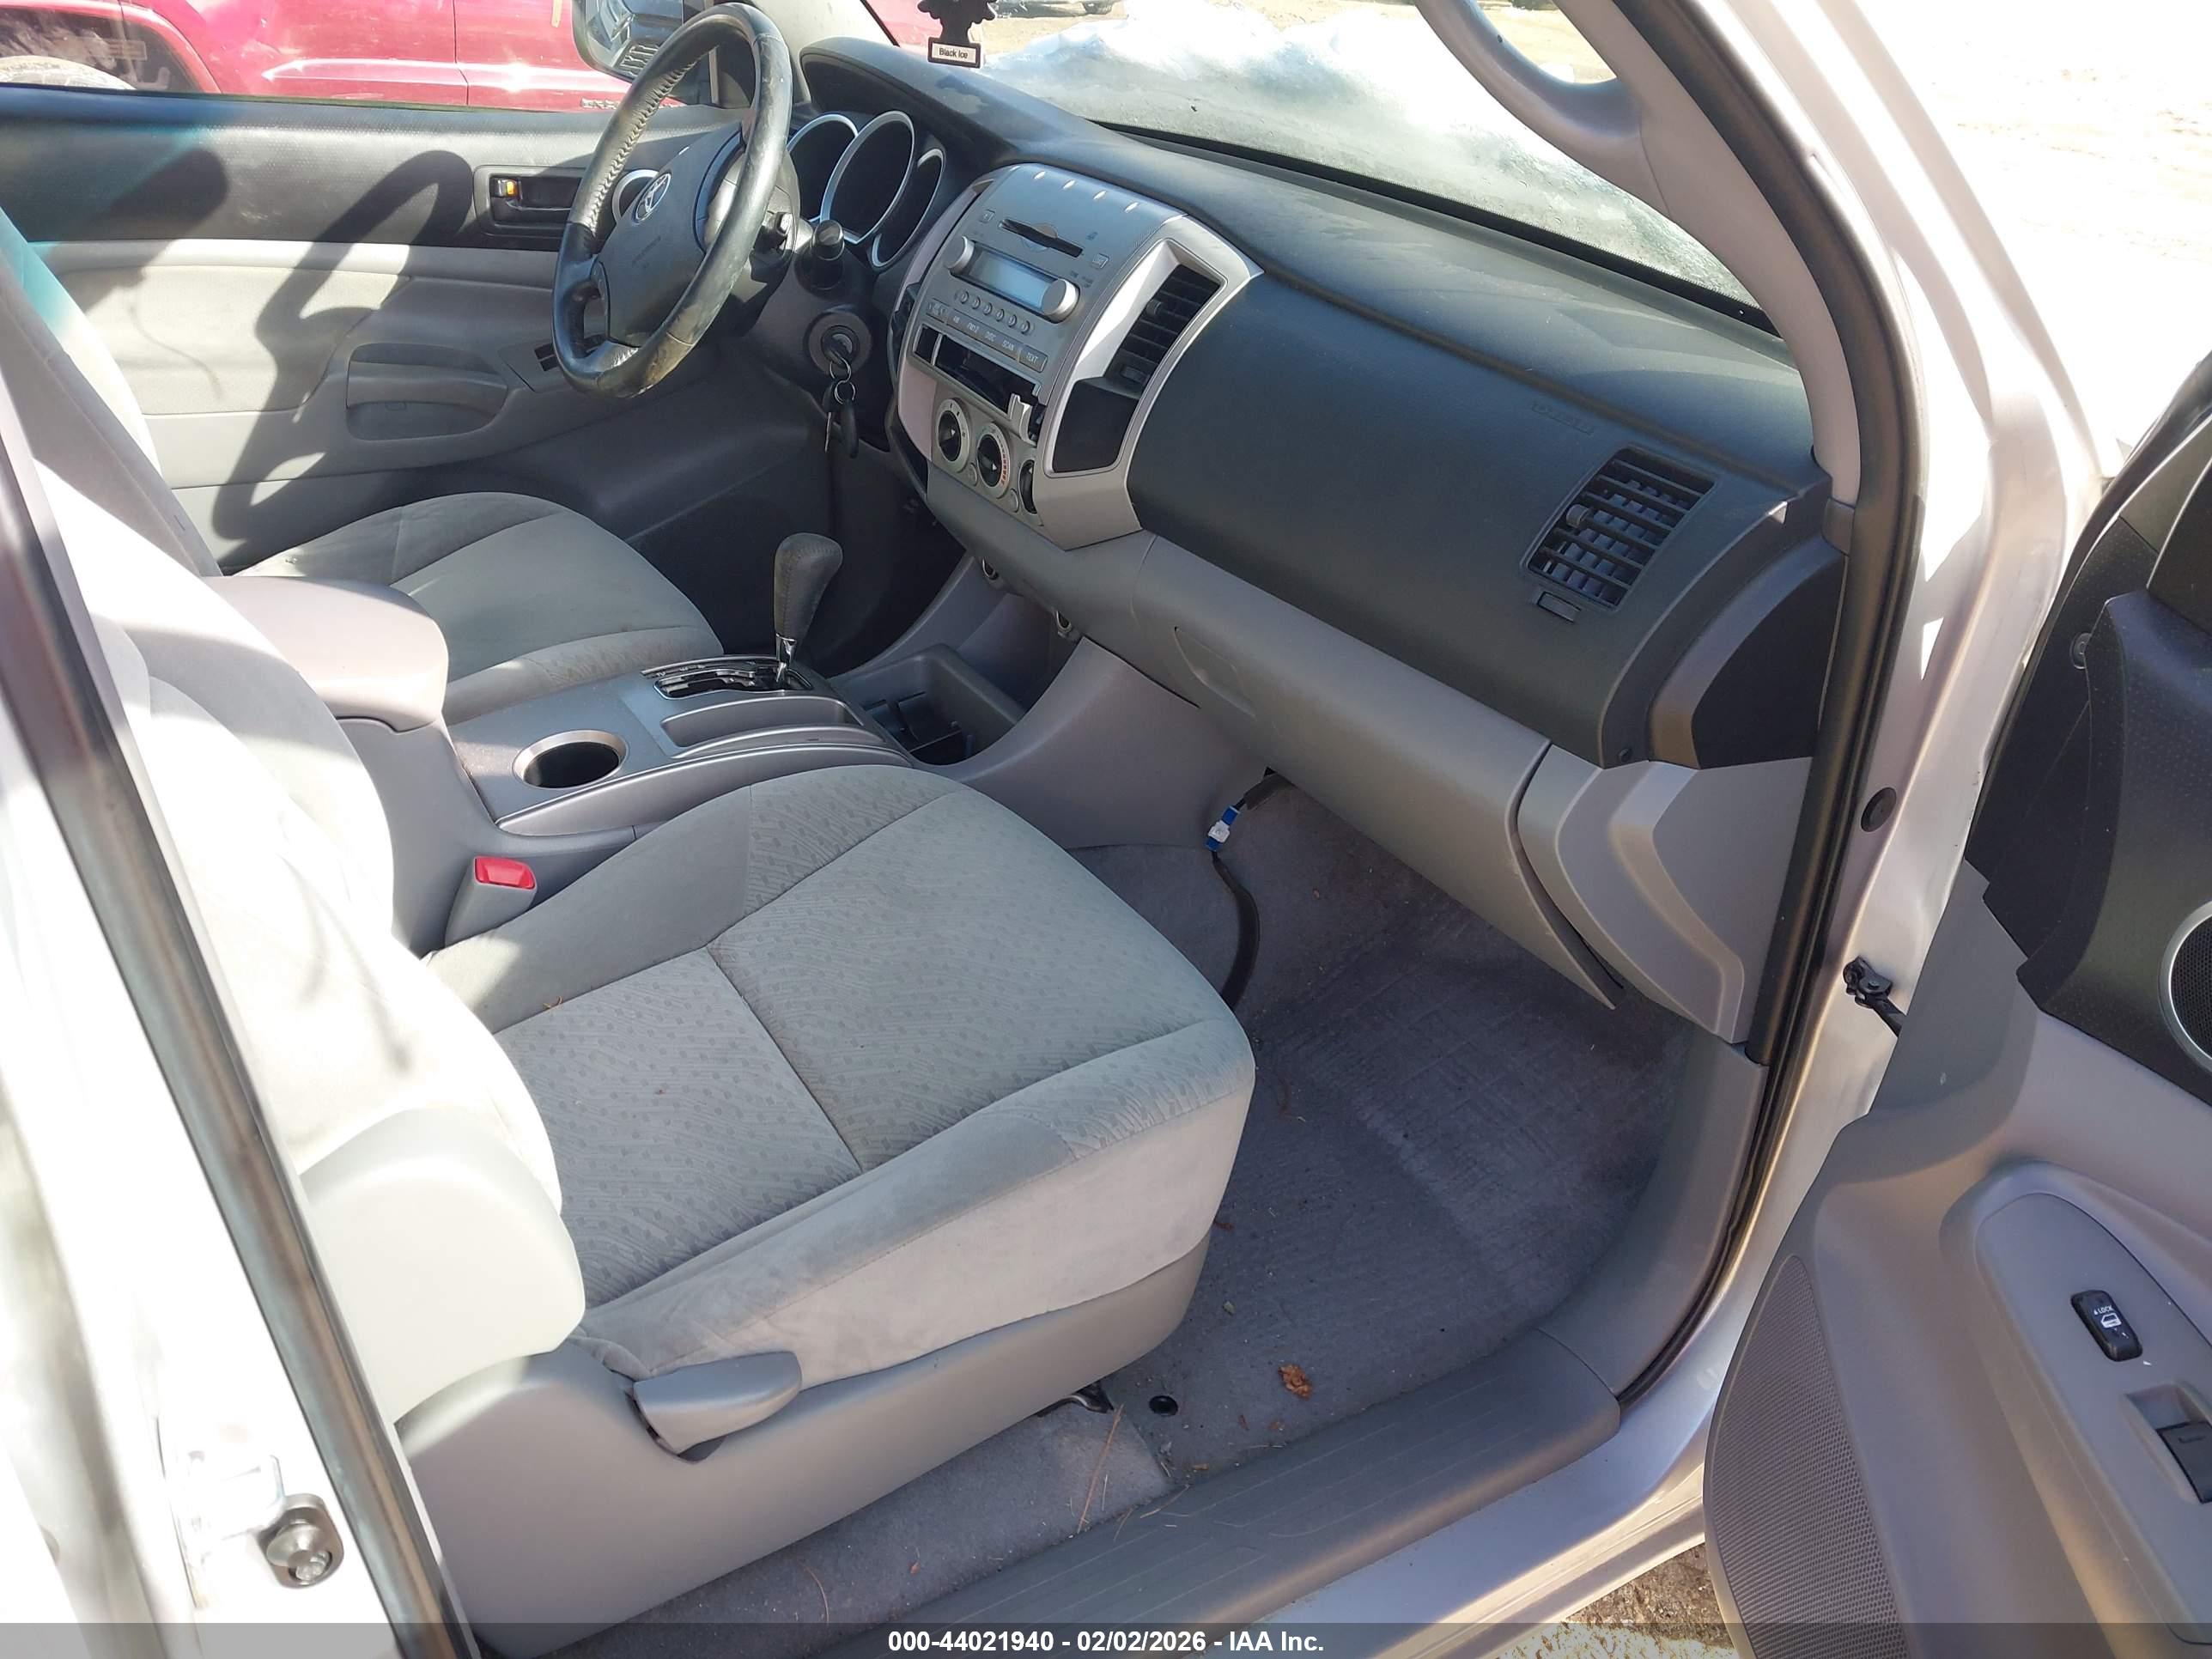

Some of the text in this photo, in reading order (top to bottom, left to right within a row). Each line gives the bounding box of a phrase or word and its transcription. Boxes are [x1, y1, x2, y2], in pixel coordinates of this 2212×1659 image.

[939, 47, 969, 59] Black Ice
[1002, 340, 1015, 351] SCAN
[1026, 352, 1039, 363] TEXT
[2098, 1304, 2114, 1315] LOCK
